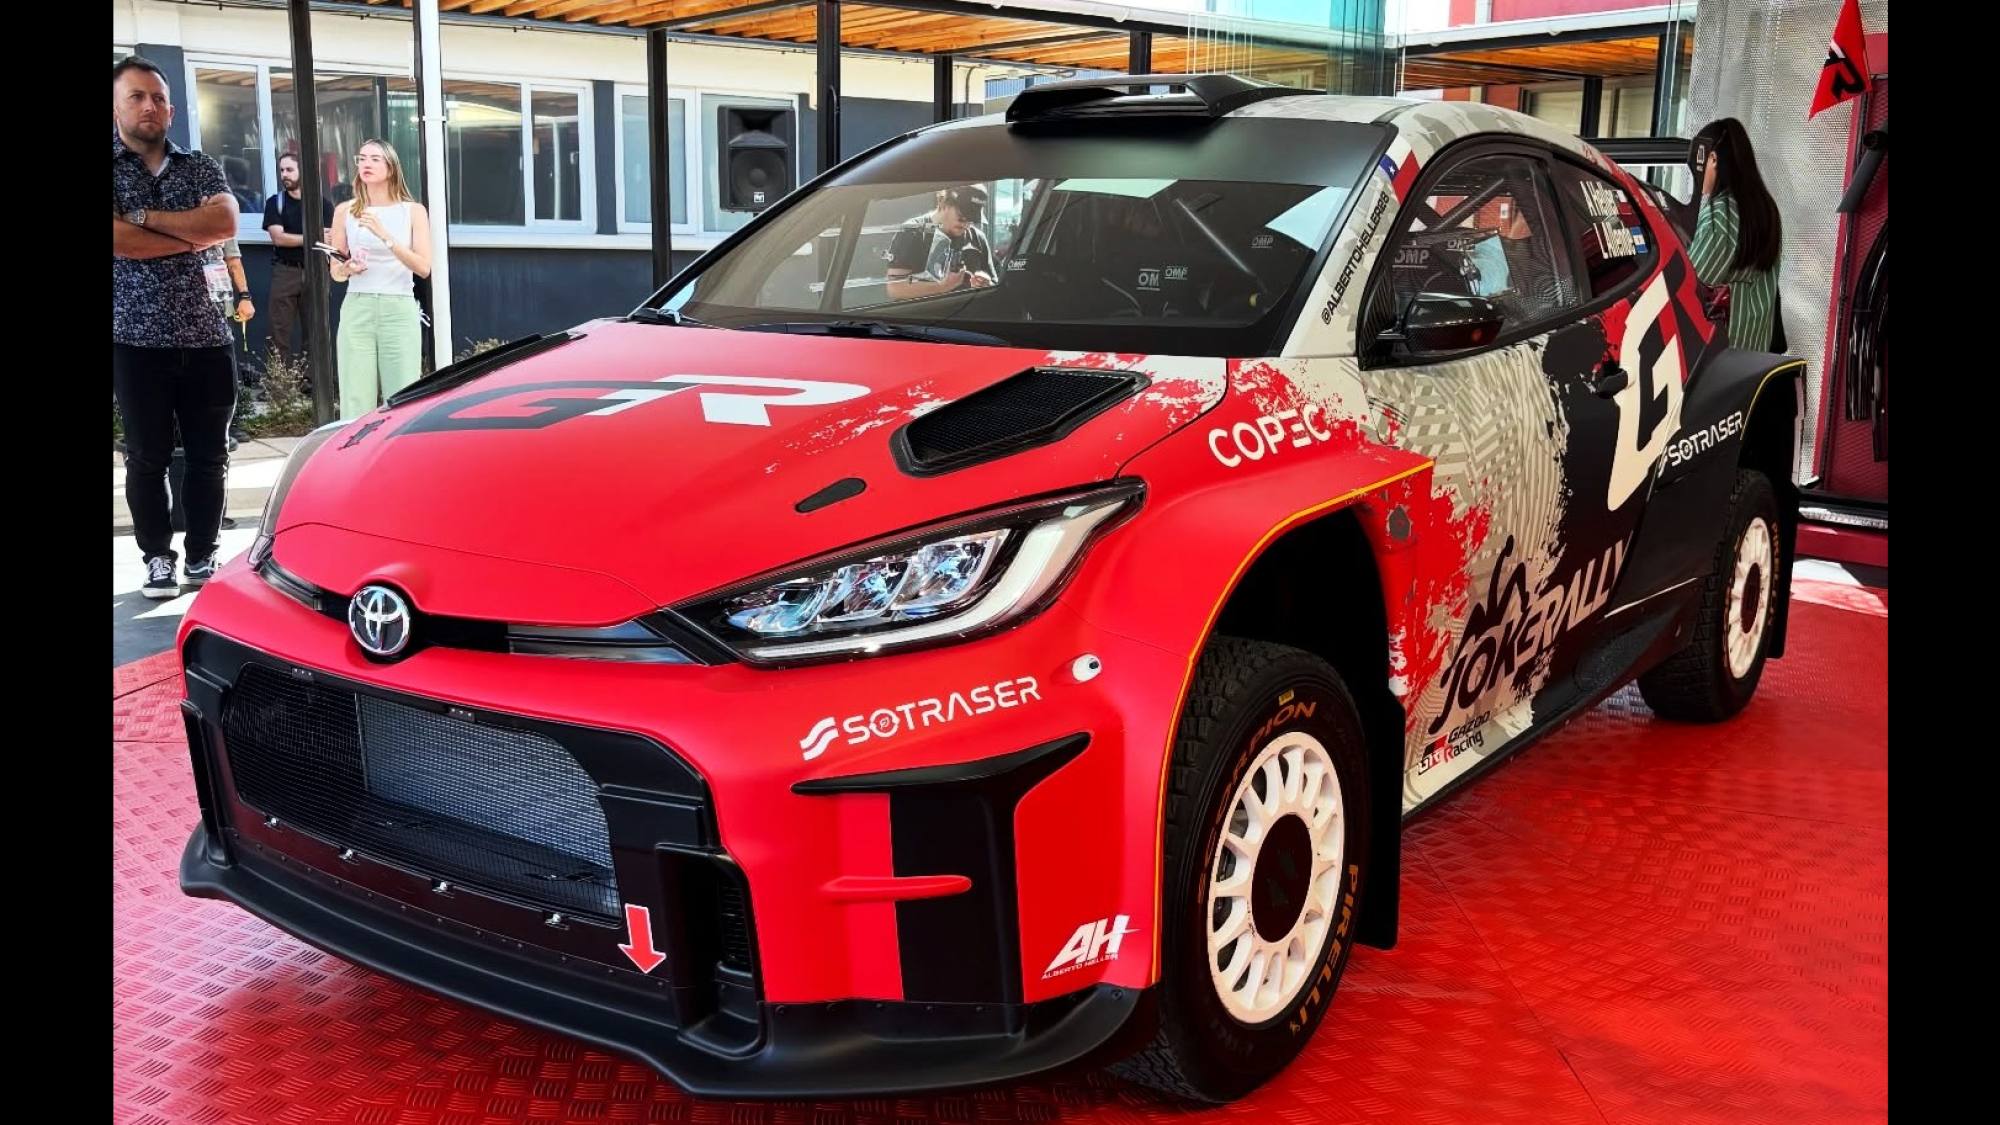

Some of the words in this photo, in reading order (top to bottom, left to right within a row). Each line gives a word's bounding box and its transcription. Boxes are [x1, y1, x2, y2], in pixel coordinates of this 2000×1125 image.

[1321, 190, 1390, 325] @ALBERTOHELLER28
[386, 373, 871, 440] GR
[1208, 403, 1332, 468] COPEC
[1667, 410, 1743, 467] SOTRASER
[842, 676, 1041, 744] SOTRASER
[1443, 730, 1485, 763] Racing
[1041, 962, 1084, 981] ALBERTO
[1043, 914, 1141, 974] AH
[1299, 863, 1359, 1030] PIRELLI
